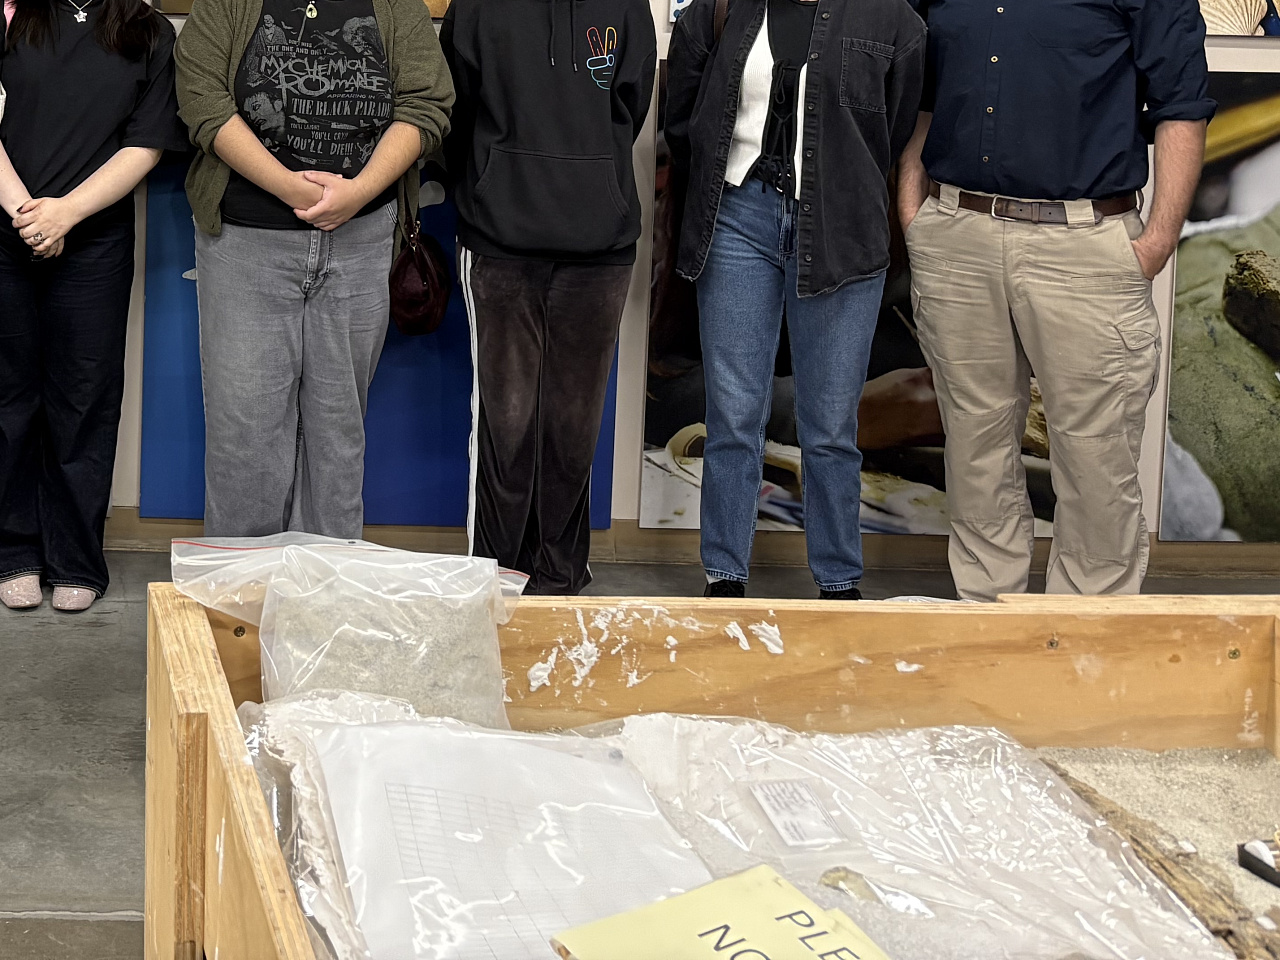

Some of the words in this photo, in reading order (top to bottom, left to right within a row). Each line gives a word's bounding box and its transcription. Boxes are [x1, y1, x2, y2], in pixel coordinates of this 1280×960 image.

[295, 47, 309, 55] AND
[310, 47, 328, 56] ONLY
[291, 98, 314, 115] THE
[315, 100, 352, 116] BLACK
[311, 130, 331, 140] YOU'LL
[286, 134, 323, 154] YOU'LL
[329, 142, 354, 156] DIE!!!
